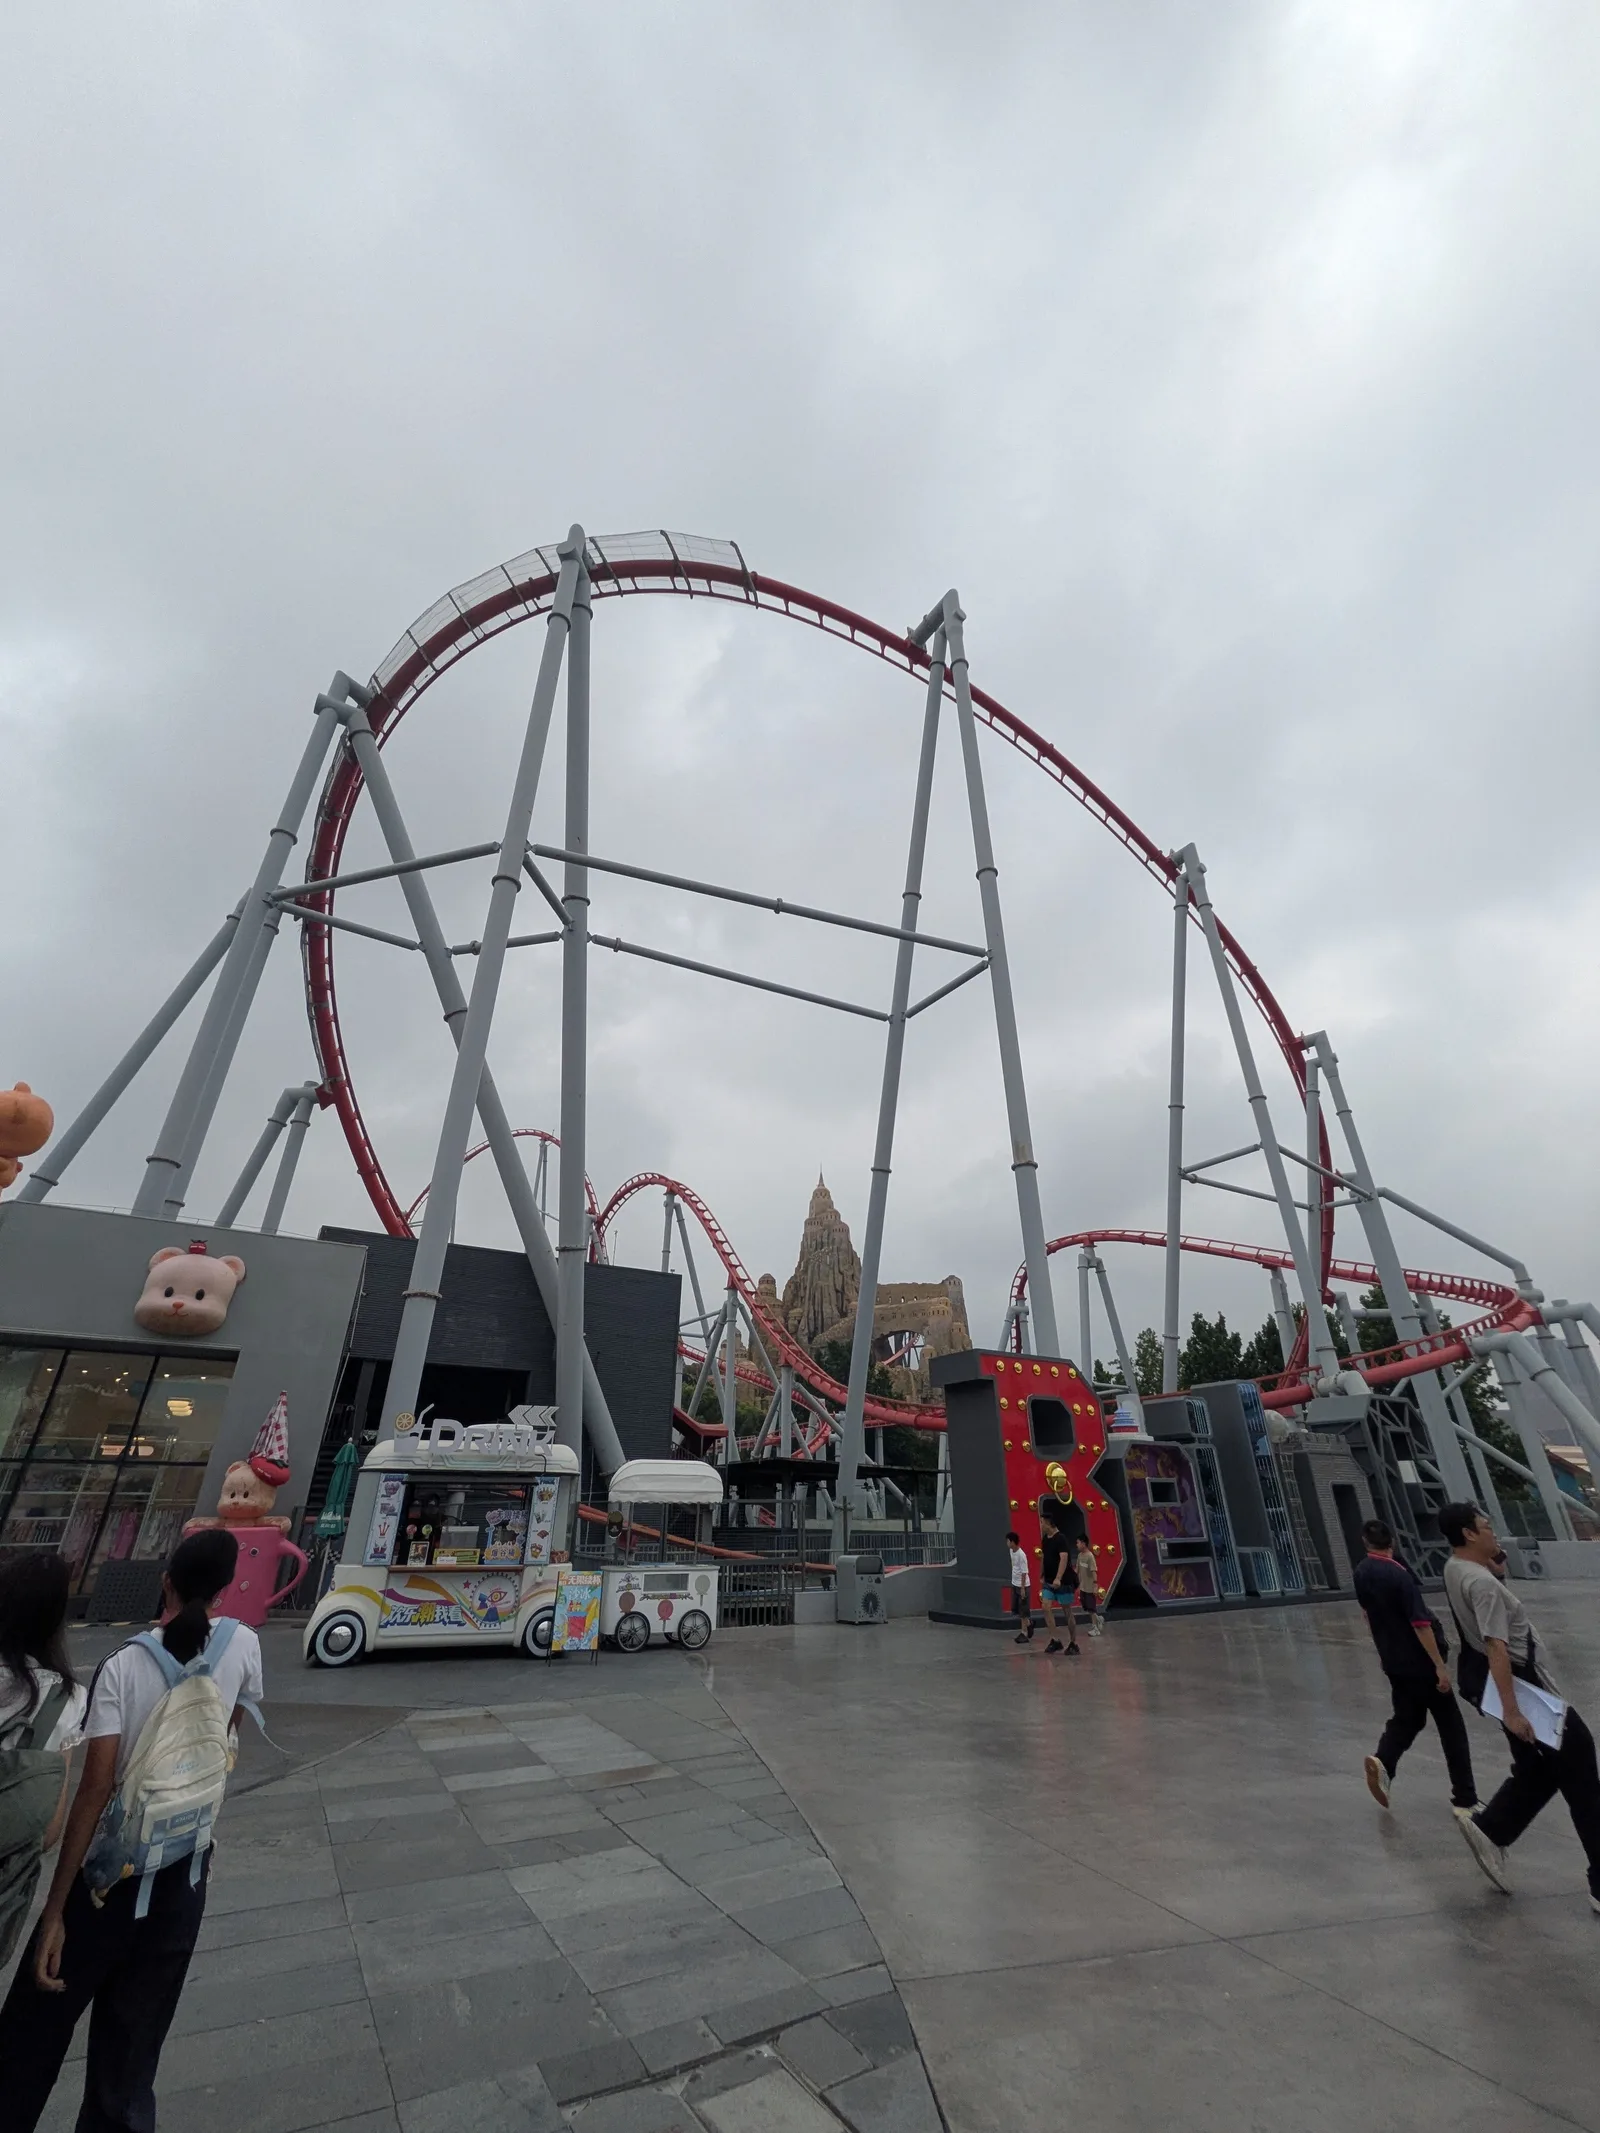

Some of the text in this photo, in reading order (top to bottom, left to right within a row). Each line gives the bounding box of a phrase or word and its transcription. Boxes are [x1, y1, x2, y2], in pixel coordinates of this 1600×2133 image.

[429, 1419, 555, 1456] DRINK
[569, 1587, 591, 1600] 沙冰
[379, 1602, 466, 1627] 欢乐潮我看
